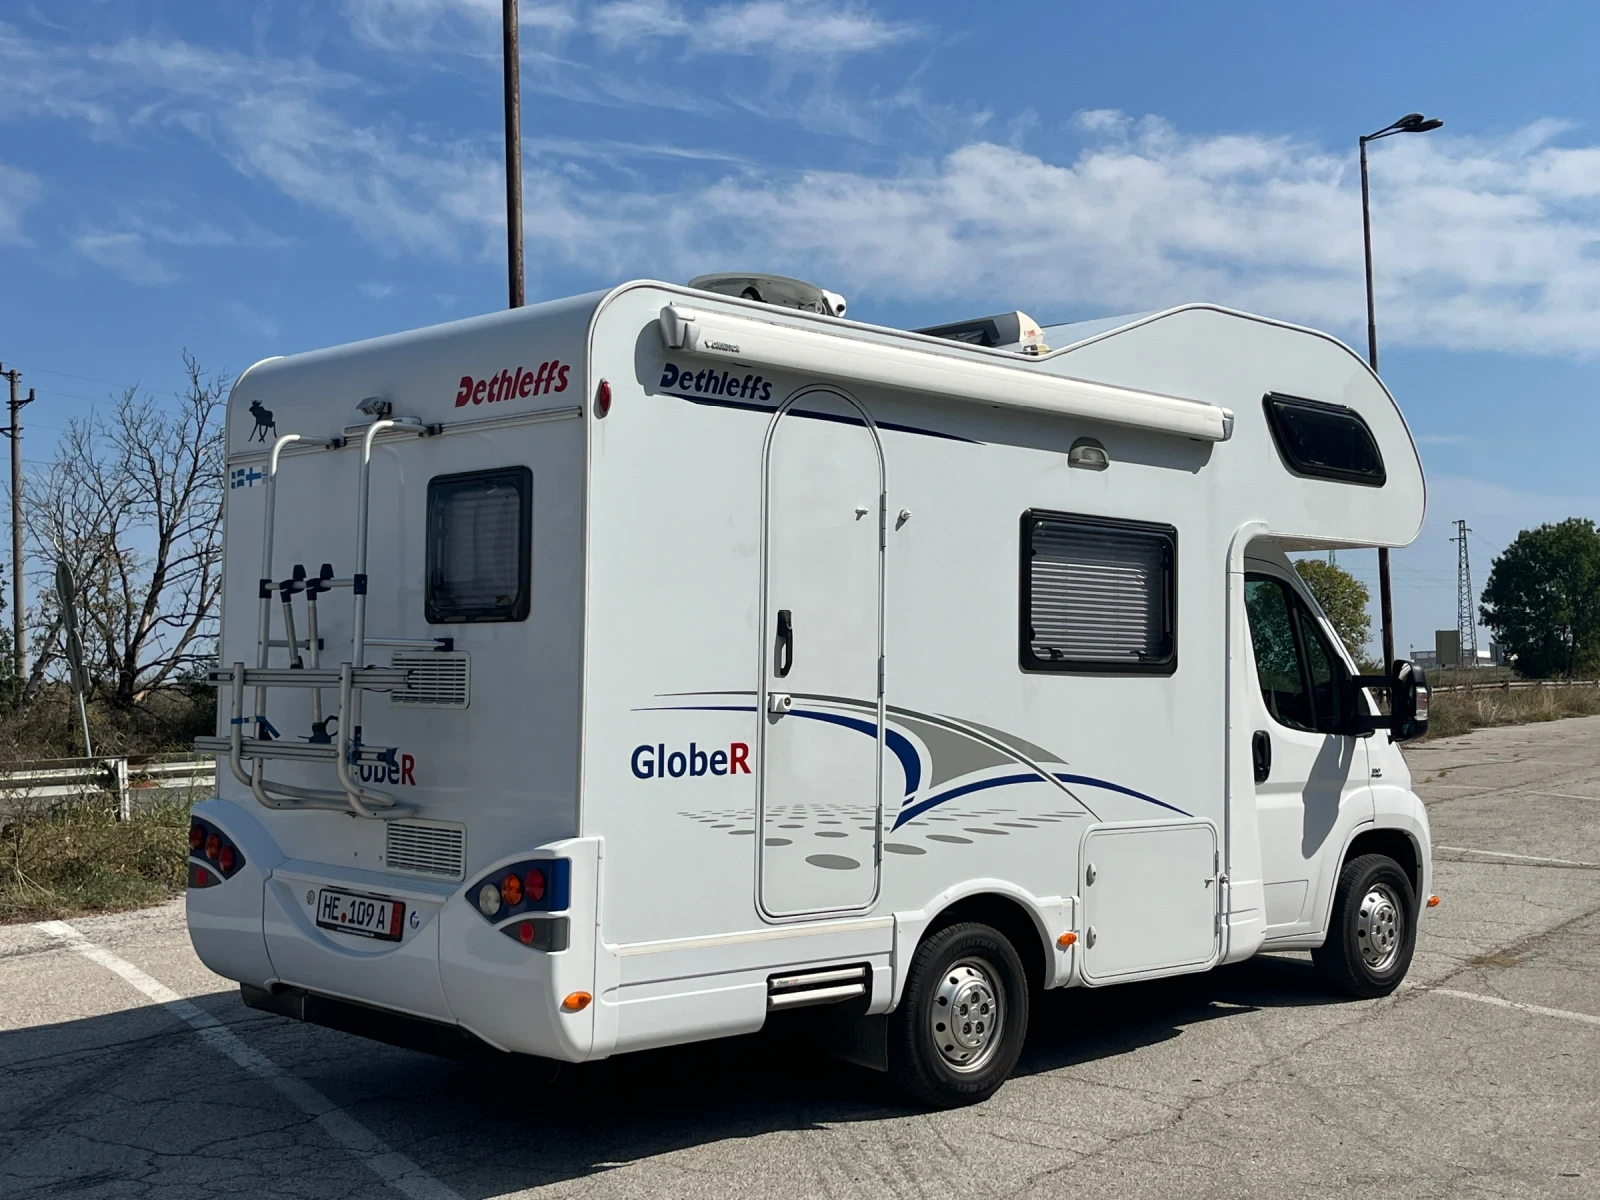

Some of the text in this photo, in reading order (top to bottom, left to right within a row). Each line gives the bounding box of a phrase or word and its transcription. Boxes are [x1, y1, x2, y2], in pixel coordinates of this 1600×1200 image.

[455, 360, 570, 407] Dethleffs
[660, 363, 772, 401] Dethleffs
[631, 742, 752, 779] GlobeR
[323, 895, 340, 921] HE
[348, 900, 375, 926] 109
[376, 904, 385, 930] A
